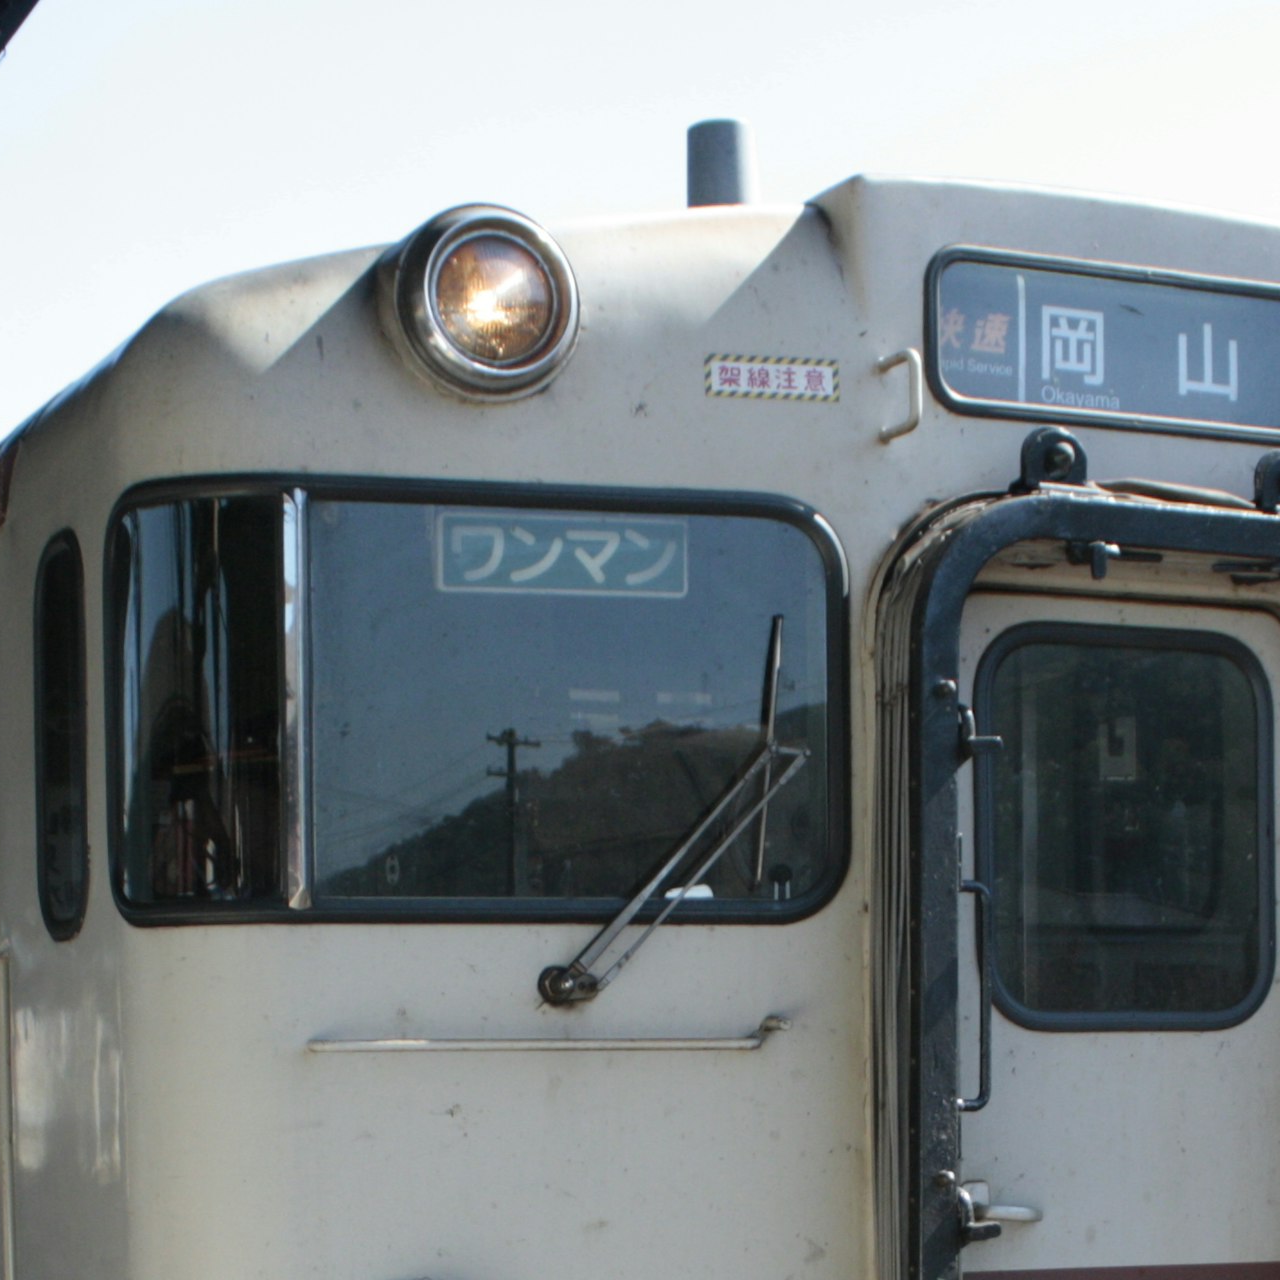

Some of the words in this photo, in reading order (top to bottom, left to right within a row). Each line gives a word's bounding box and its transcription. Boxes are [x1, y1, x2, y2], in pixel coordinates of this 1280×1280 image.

[967, 357, 1013, 377] Service
[1041, 304, 1238, 402] 岡山
[718, 364, 826, 392] 架線注意
[1041, 385, 1120, 409] Okayama
[451, 525, 677, 586] ワンマン
